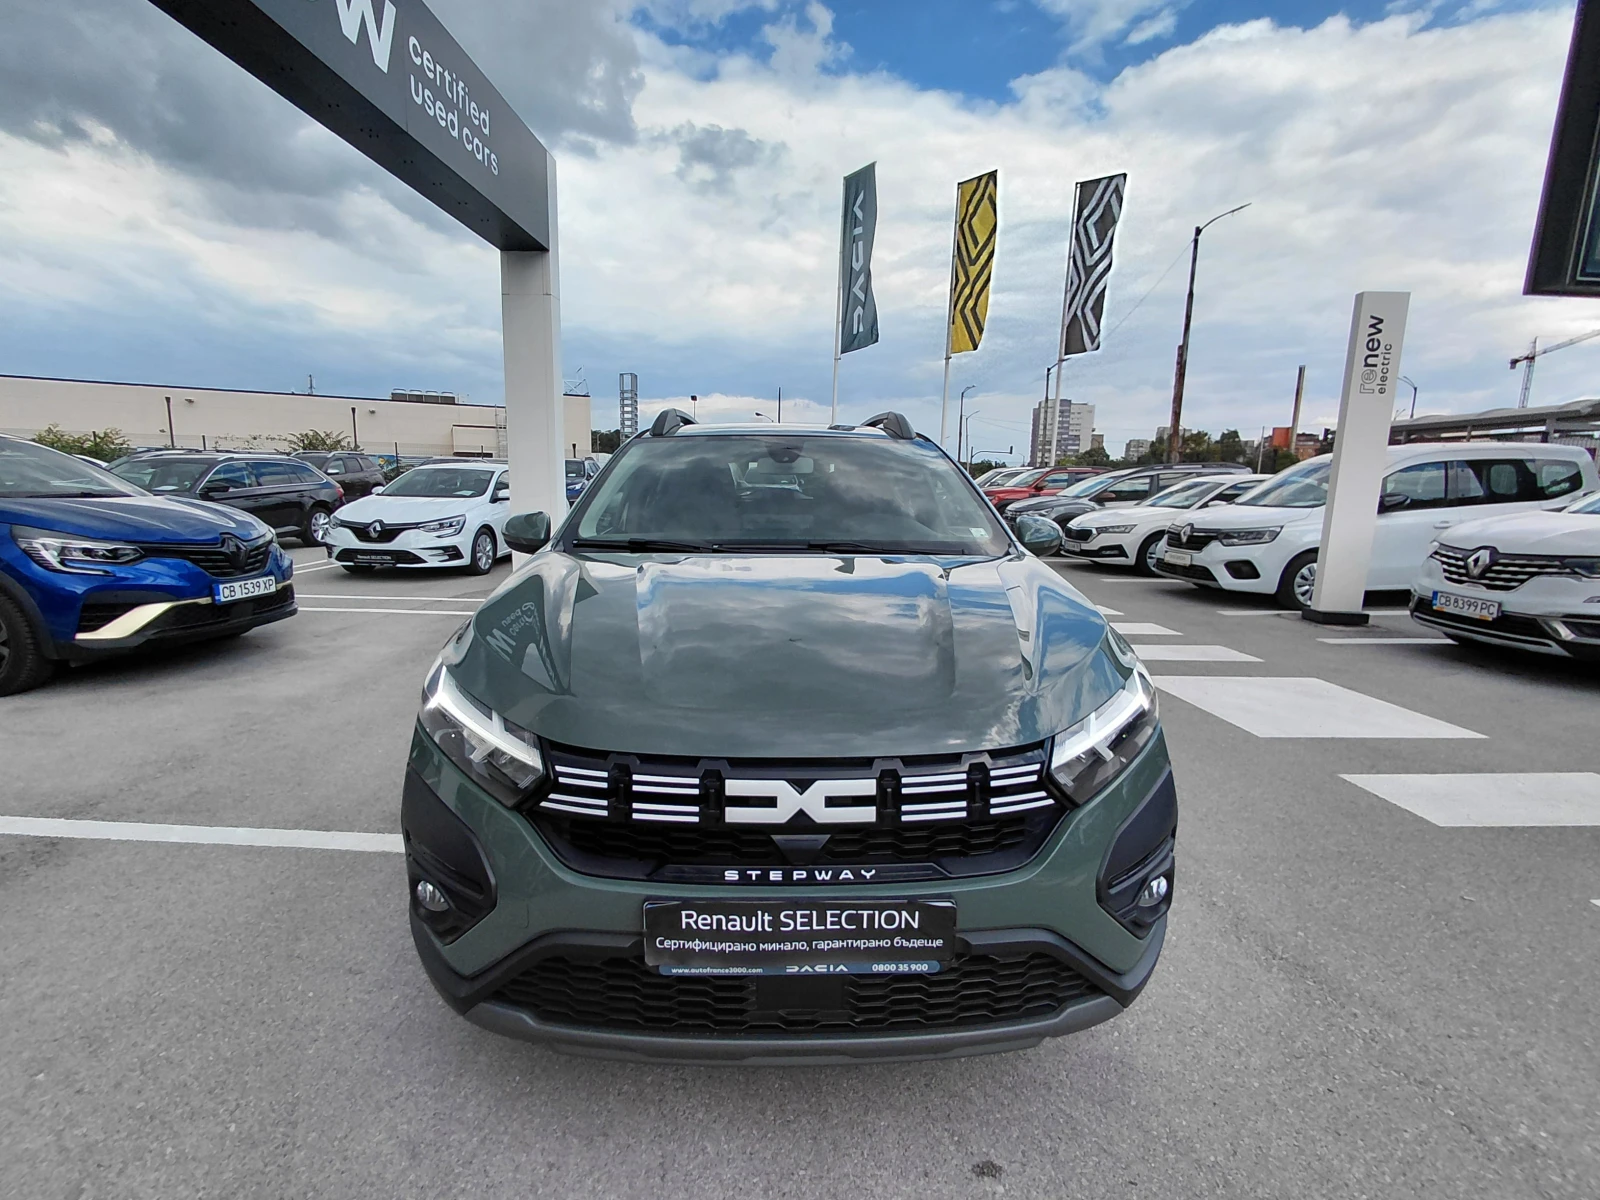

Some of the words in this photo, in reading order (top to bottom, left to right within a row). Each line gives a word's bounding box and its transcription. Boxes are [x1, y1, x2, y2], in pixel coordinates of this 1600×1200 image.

[408, 35, 490, 137] certified
[410, 74, 459, 140] used
[463, 127, 499, 176] cars
[1360, 314, 1384, 394] renew
[1376, 343, 1392, 394] electric
[239, 580, 261, 596] 1539
[1453, 597, 1479, 612] 8399
[724, 869, 876, 881] STEPWAY
[681, 910, 773, 931] Renault
[779, 910, 919, 931] SELECTION
[656, 937, 757, 953] Сертифицирано
[760, 941, 810, 952] минало,
[812, 938, 891, 951] гарантирано
[894, 936, 944, 949] бъдеще
[786, 964, 849, 972] DACIA
[872, 963, 897, 972] 0800
[898, 963, 909, 972] 35
[910, 963, 928, 972] 900
